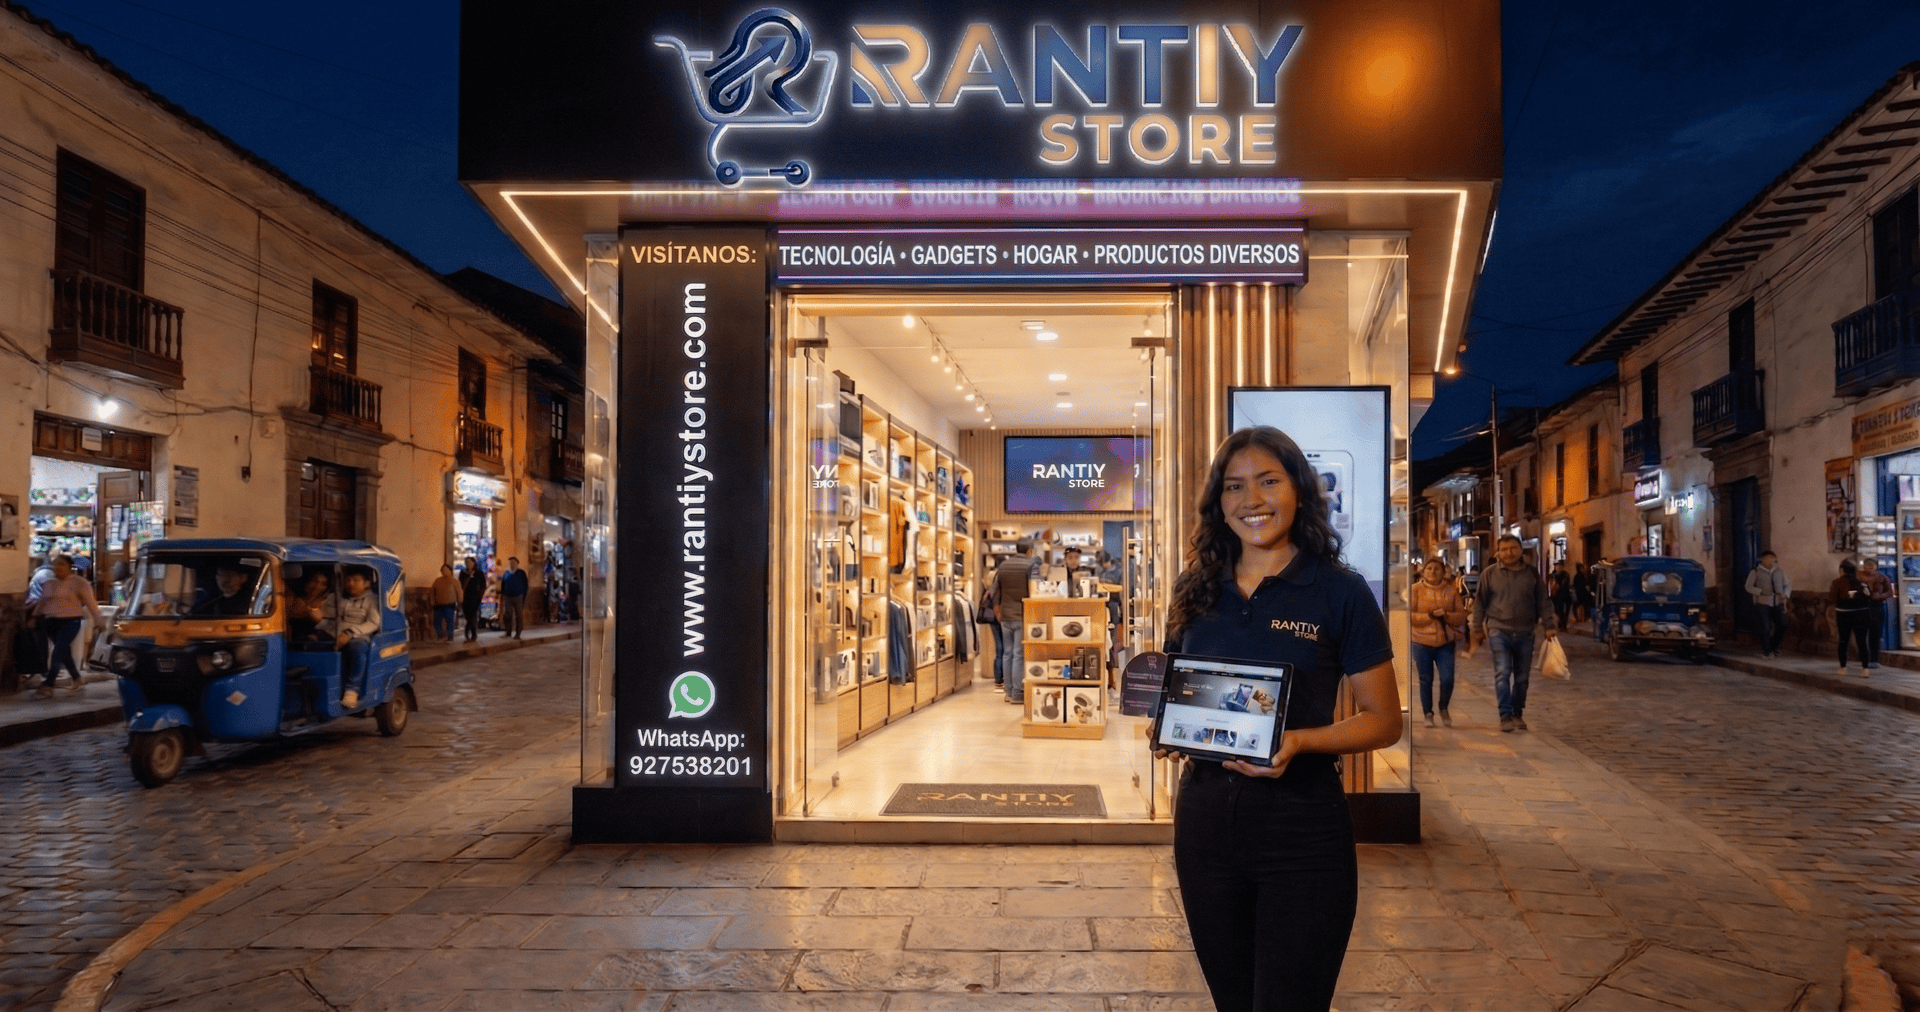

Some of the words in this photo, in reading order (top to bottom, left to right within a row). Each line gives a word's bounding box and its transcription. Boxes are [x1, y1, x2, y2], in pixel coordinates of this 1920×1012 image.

[851, 24, 1304, 107] RANTIY
[1038, 114, 1276, 165] STORE
[631, 241, 757, 264] VISÍTANOS:
[779, 241, 895, 265] TECNOLOGÍA
[911, 245, 997, 265] GADGETS
[1013, 245, 1078, 265] HOGAR
[1094, 244, 1204, 265] PRODUCTOS
[1210, 244, 1300, 265] DIVERSOS
[677, 282, 713, 657] www.rantiystore.com
[1032, 463, 1106, 479] RANTIY
[1068, 479, 1105, 488] STORE
[1270, 619, 1320, 635] RANTIY
[1294, 630, 1318, 642] STORE
[638, 729, 745, 751] WhatsApp:
[630, 756, 751, 776] 927538201
[916, 791, 1076, 803] RANTIY
